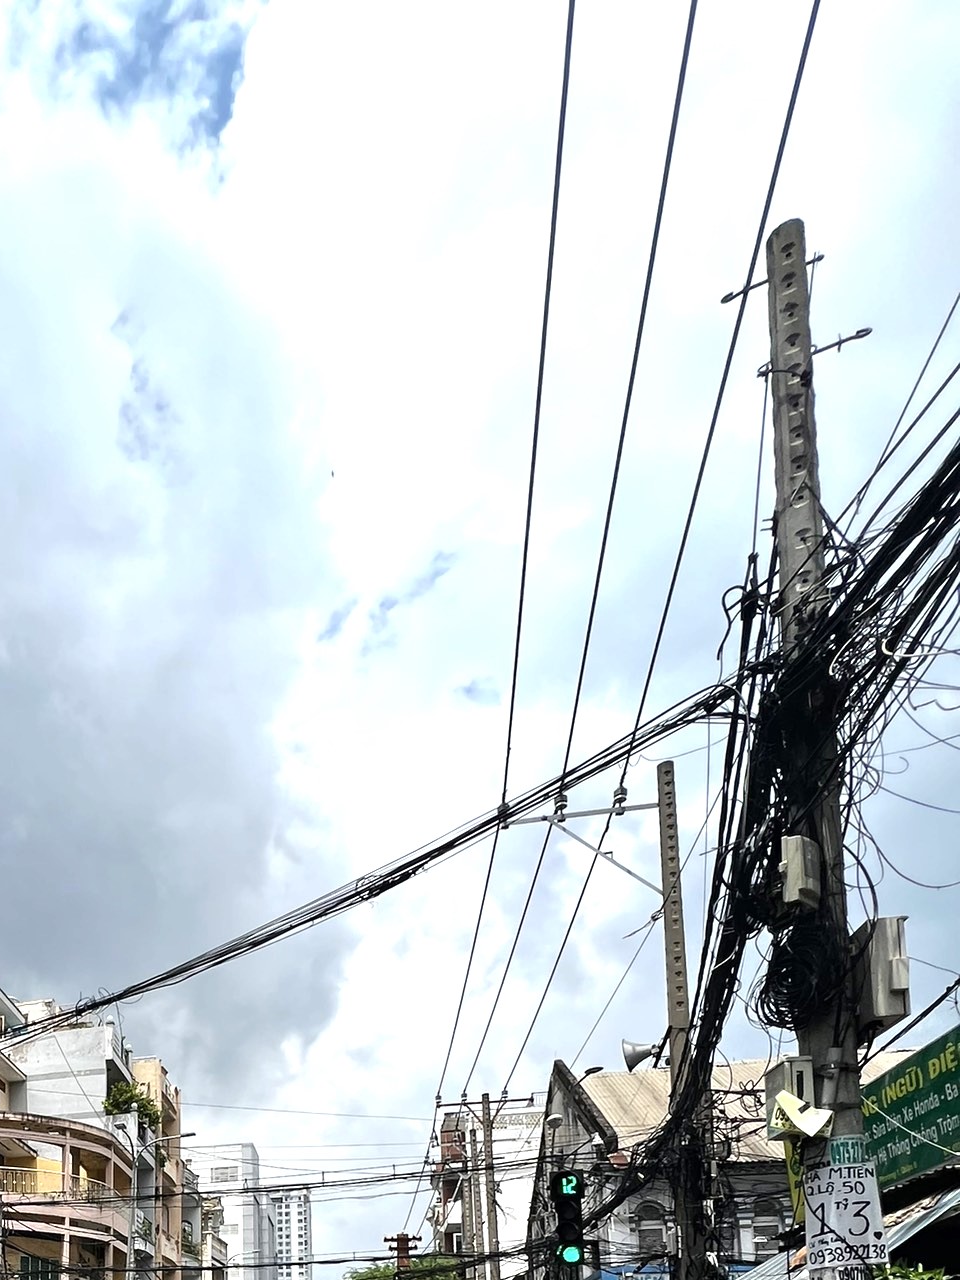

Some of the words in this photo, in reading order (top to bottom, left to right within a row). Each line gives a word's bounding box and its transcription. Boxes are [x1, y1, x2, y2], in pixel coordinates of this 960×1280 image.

[928, 1042, 960, 1080] ĐIỆ
[902, 1106, 914, 1124] Xe
[913, 1092, 940, 1117] Honda
[945, 1082, 959, 1101] Ba
[562, 1176, 577, 1194] 12
[848, 1200, 872, 1237] 3
